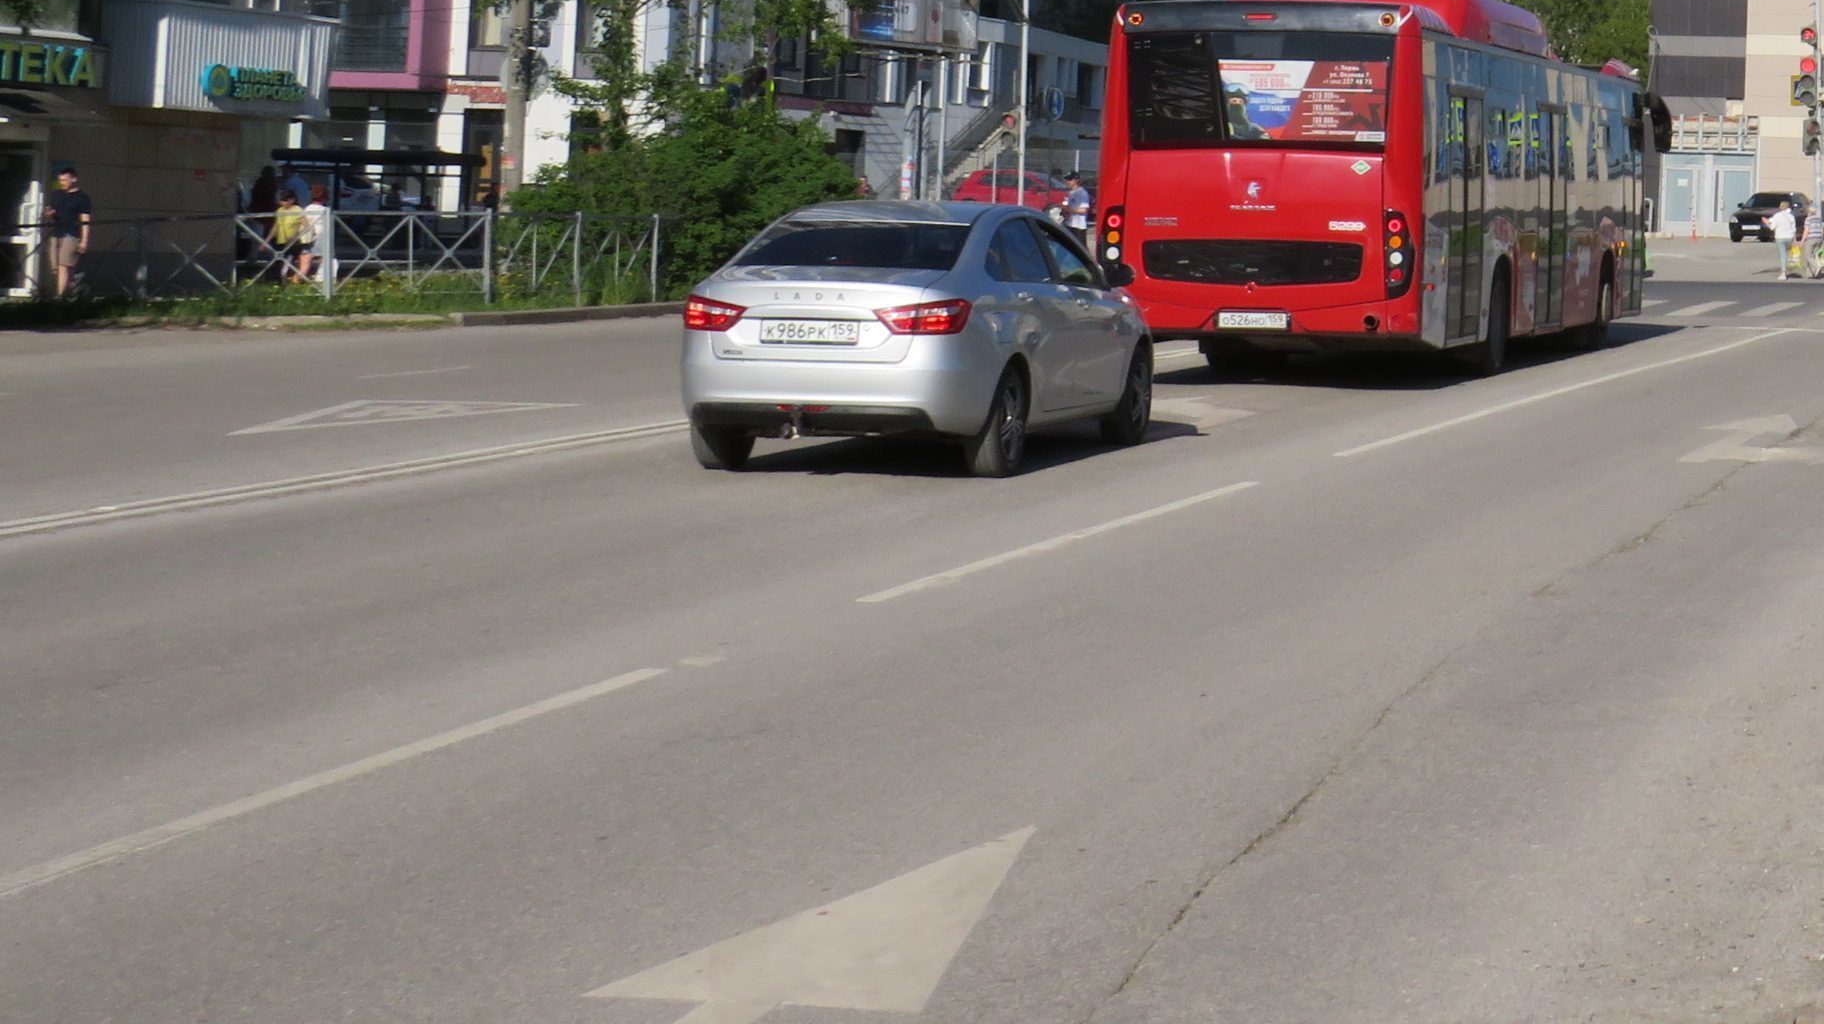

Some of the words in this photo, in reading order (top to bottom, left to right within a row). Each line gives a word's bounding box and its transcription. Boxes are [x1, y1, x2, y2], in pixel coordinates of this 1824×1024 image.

[774, 292, 845, 301] LADA
[765, 322, 827, 340] К986РК
[831, 323, 854, 336] 159
